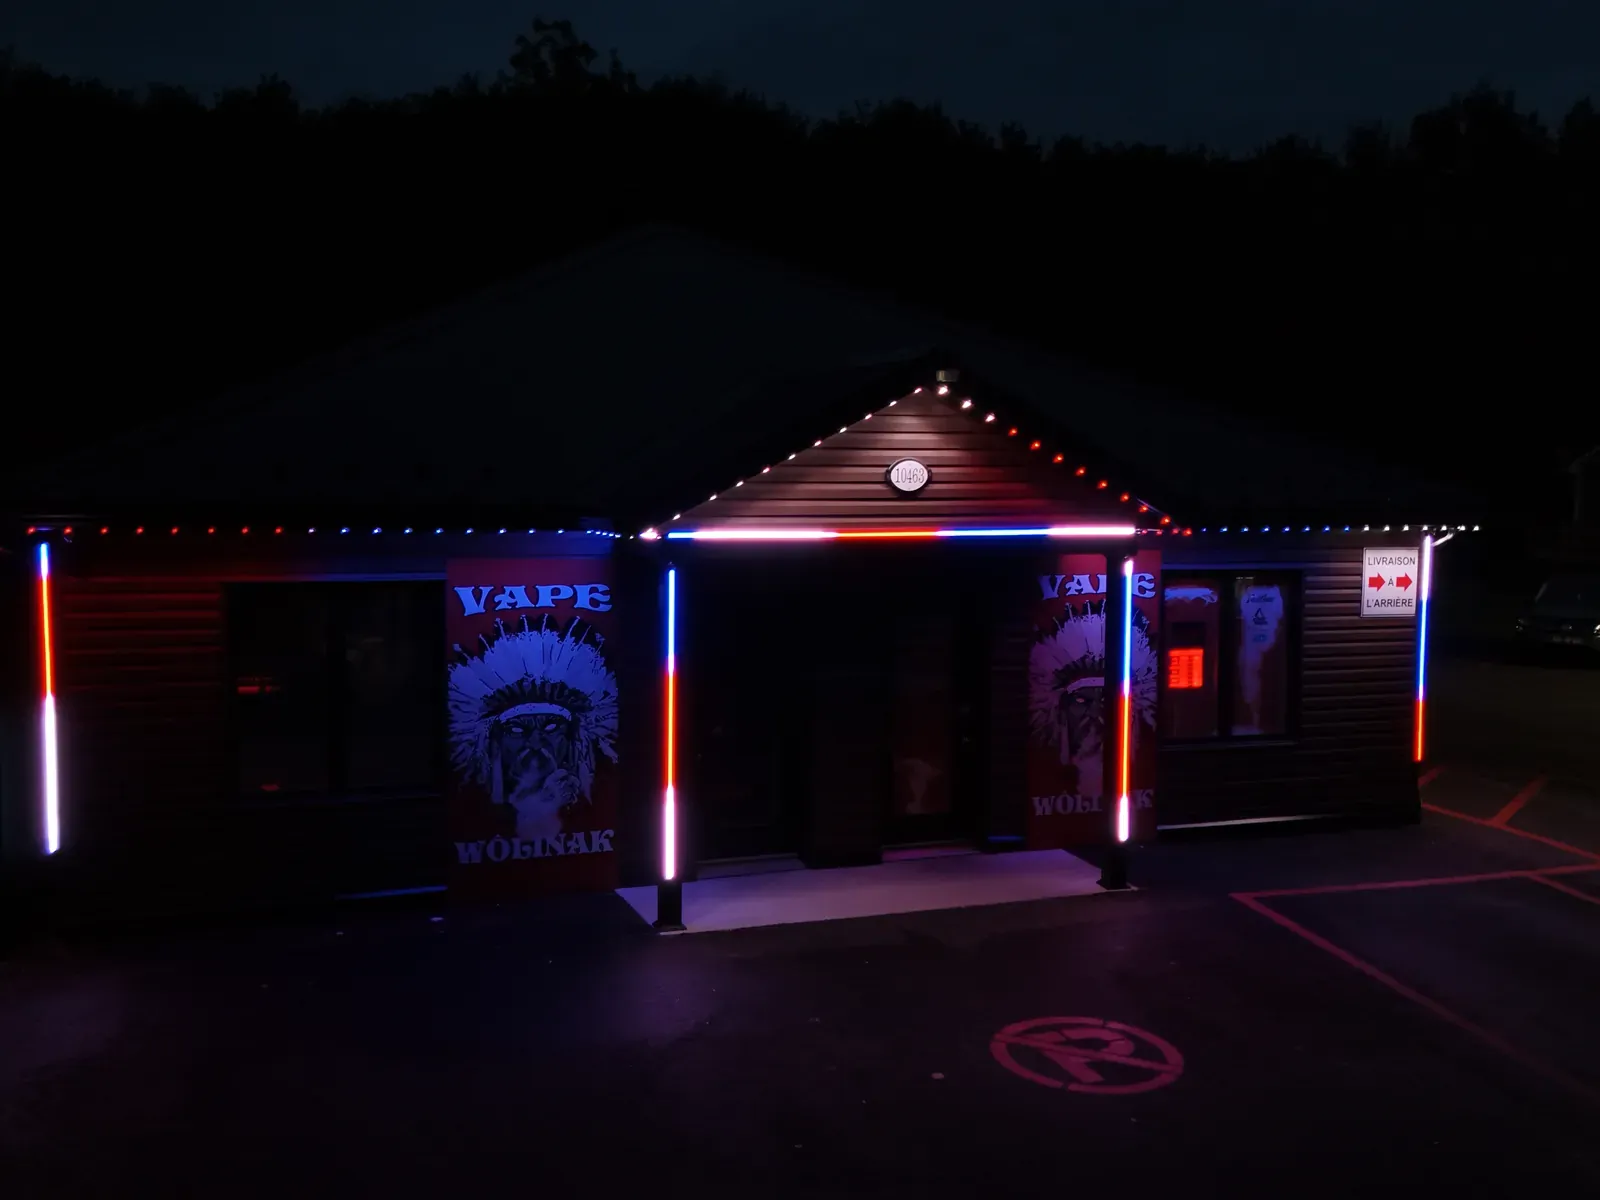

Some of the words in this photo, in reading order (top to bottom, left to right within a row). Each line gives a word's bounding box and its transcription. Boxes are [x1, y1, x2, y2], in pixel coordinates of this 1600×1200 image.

[895, 468, 925, 484] 10463
[1367, 556, 1416, 566] LIVRAISON
[453, 584, 613, 616] VAPE
[1038, 573, 1156, 600] VAE
[1366, 596, 1414, 608] L'ARRIÈRE
[1030, 787, 1155, 816] WÔLIK
[453, 829, 615, 864] WÔLINAK
